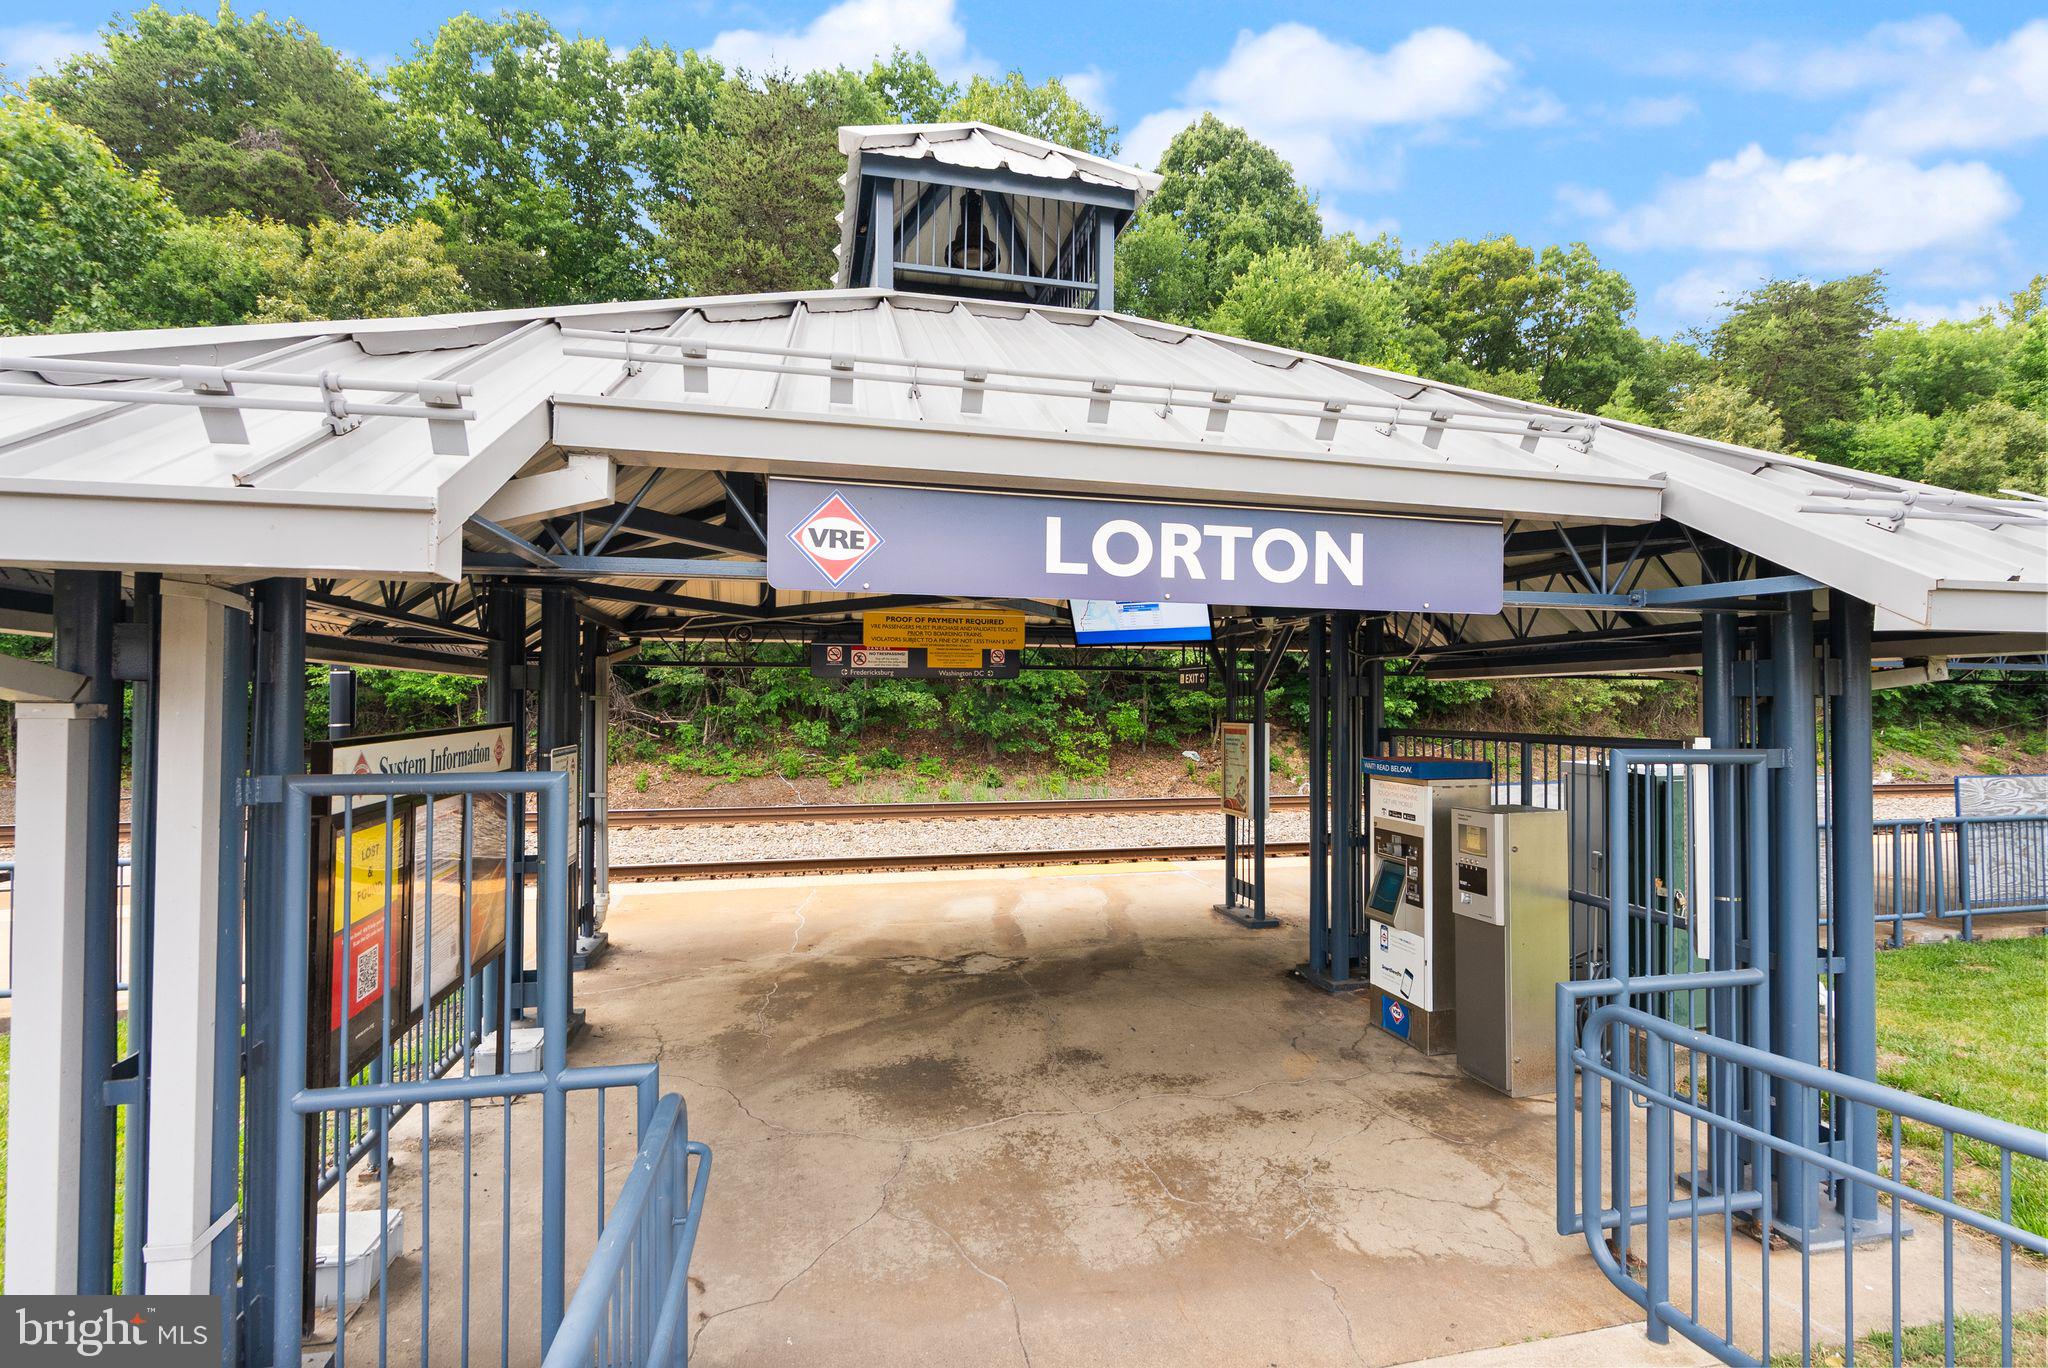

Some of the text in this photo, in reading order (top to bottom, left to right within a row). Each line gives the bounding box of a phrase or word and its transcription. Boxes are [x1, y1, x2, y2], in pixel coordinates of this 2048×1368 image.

[807, 527, 865, 550] VRE
[1045, 516, 1364, 587] LORTON
[850, 669, 894, 677] Fredericksburg
[938, 669, 973, 678] Washington
[1185, 673, 1199, 684] EXIT
[430, 742, 490, 774] Information
[1376, 764, 1390, 772] READ
[361, 843, 380, 861] LOST
